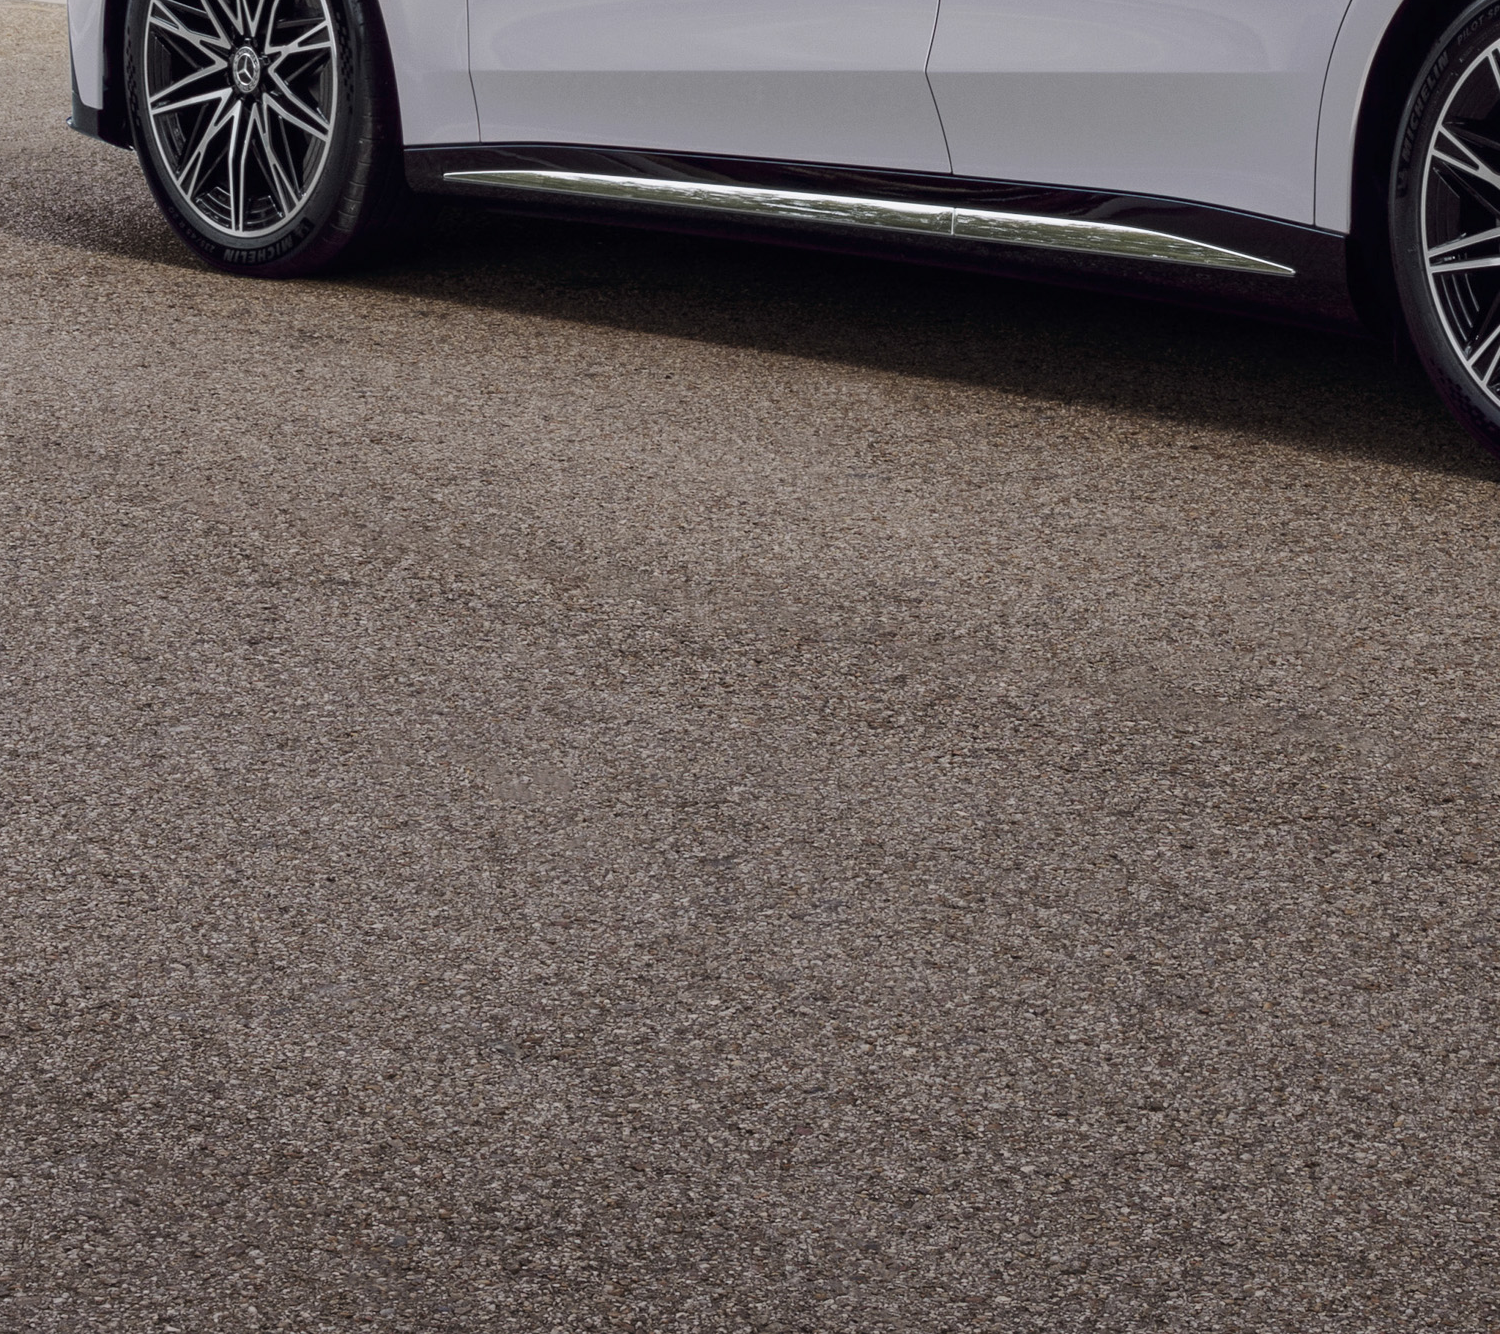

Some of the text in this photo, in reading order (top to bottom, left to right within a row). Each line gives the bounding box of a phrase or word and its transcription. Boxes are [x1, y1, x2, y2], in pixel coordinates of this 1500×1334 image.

[1457, 14, 1485, 46] PILOT
[1401, 50, 1450, 162] MICHELIN
[223, 236, 294, 265] MICHELIN
